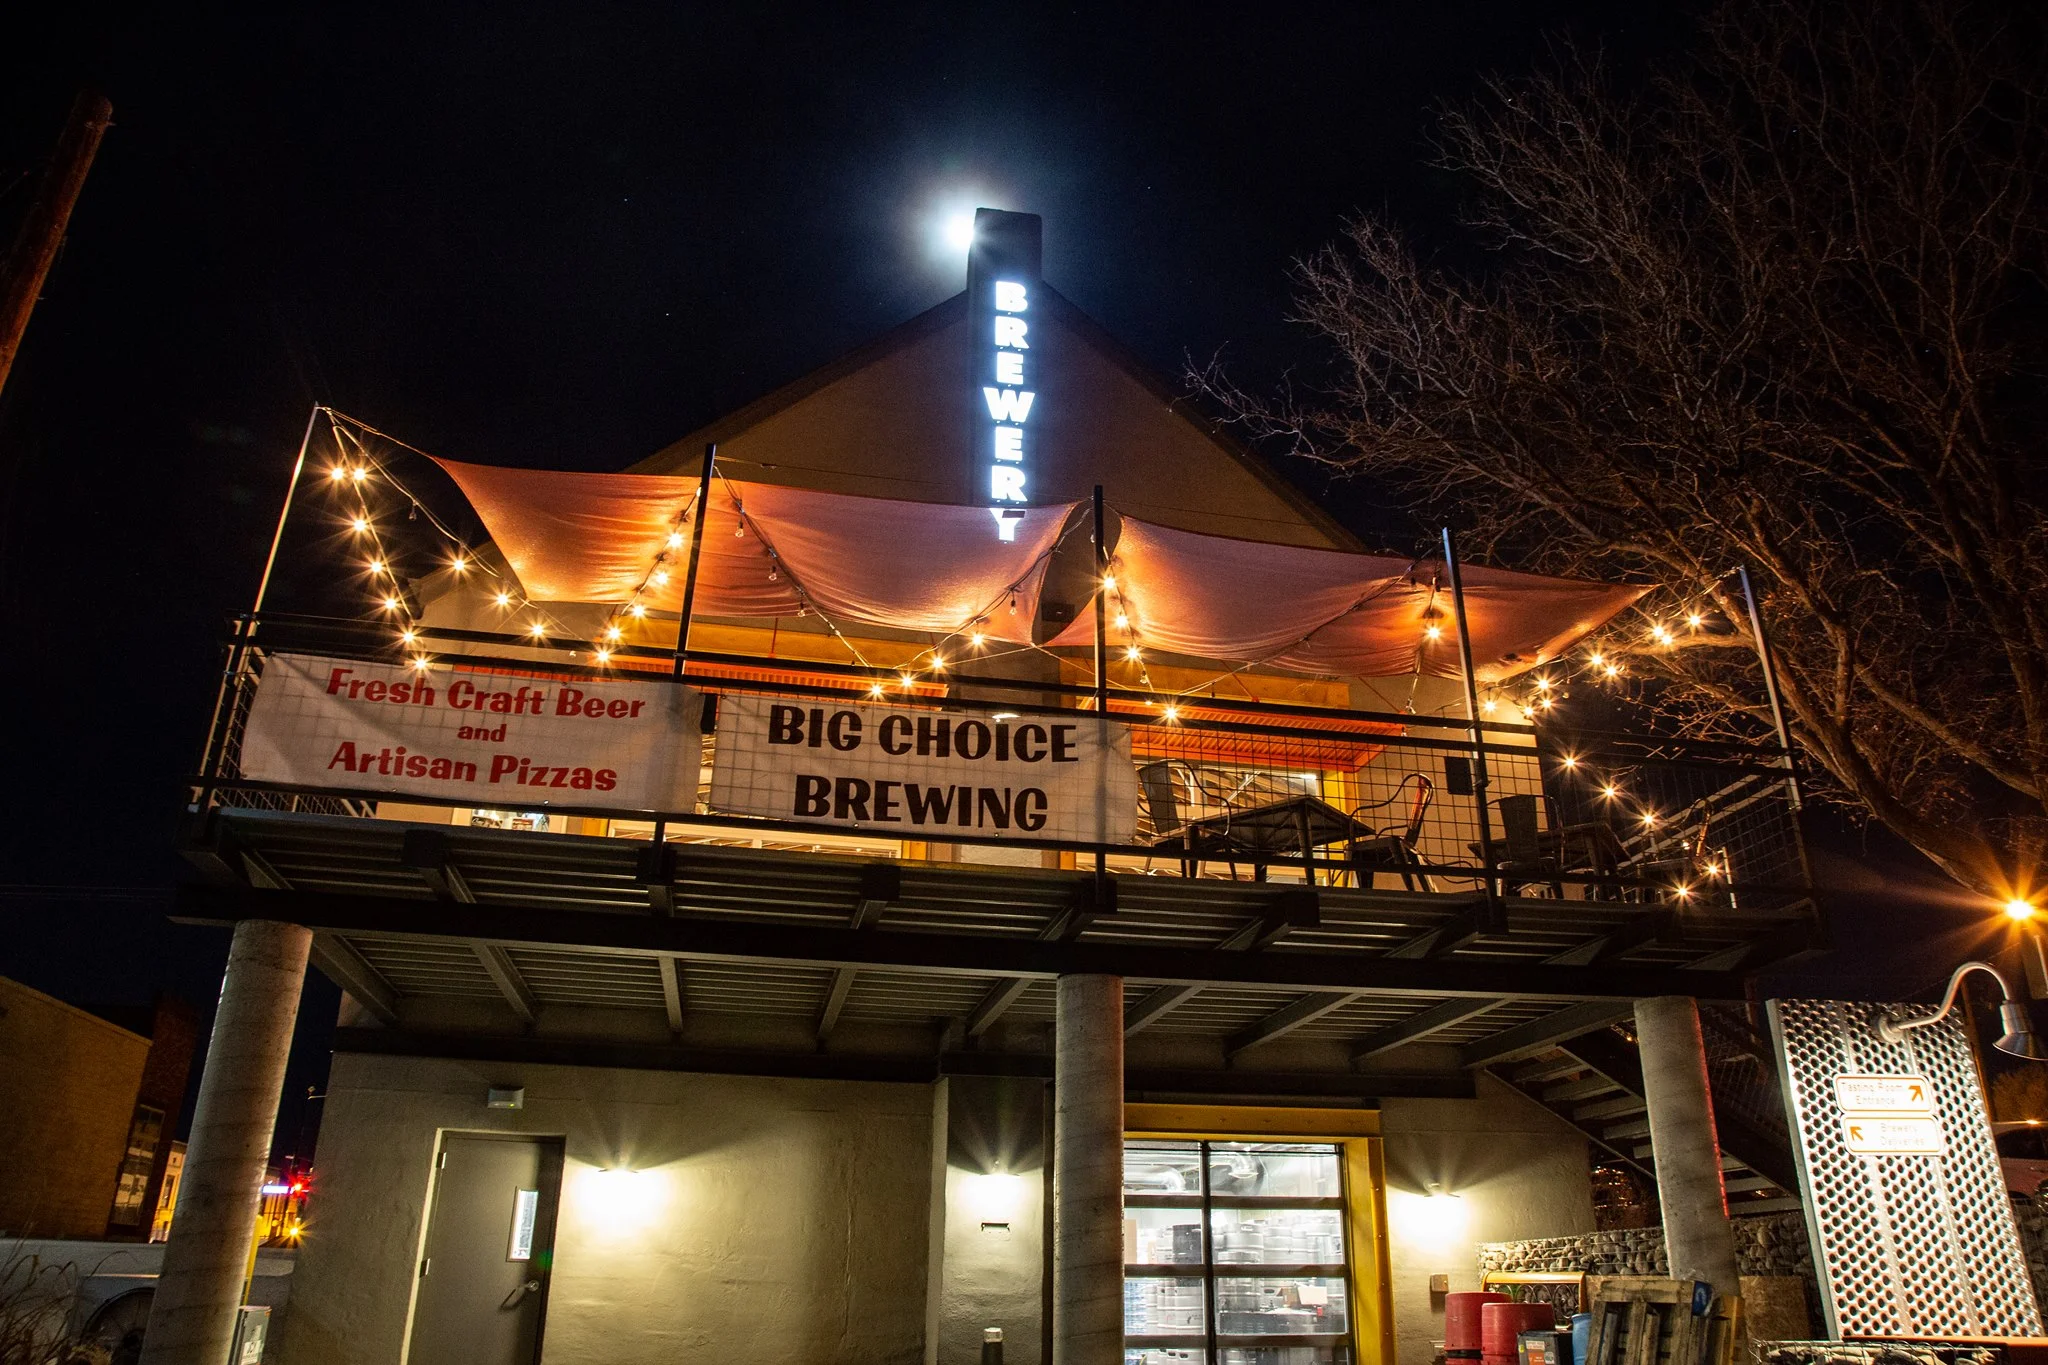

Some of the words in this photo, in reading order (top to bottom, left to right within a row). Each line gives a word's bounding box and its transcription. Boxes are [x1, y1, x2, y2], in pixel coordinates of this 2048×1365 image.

[983, 280, 1036, 542] BREWERY
[326, 668, 435, 707] Fresh
[447, 680, 546, 716] Craft
[555, 688, 646, 719] Beer
[457, 723, 507, 743] and
[768, 704, 863, 751] BIG
[878, 715, 1079, 763] CHOICE
[328, 742, 478, 782] Artisan
[490, 755, 618, 791] Pizzas
[793, 774, 1049, 832] BREWING
